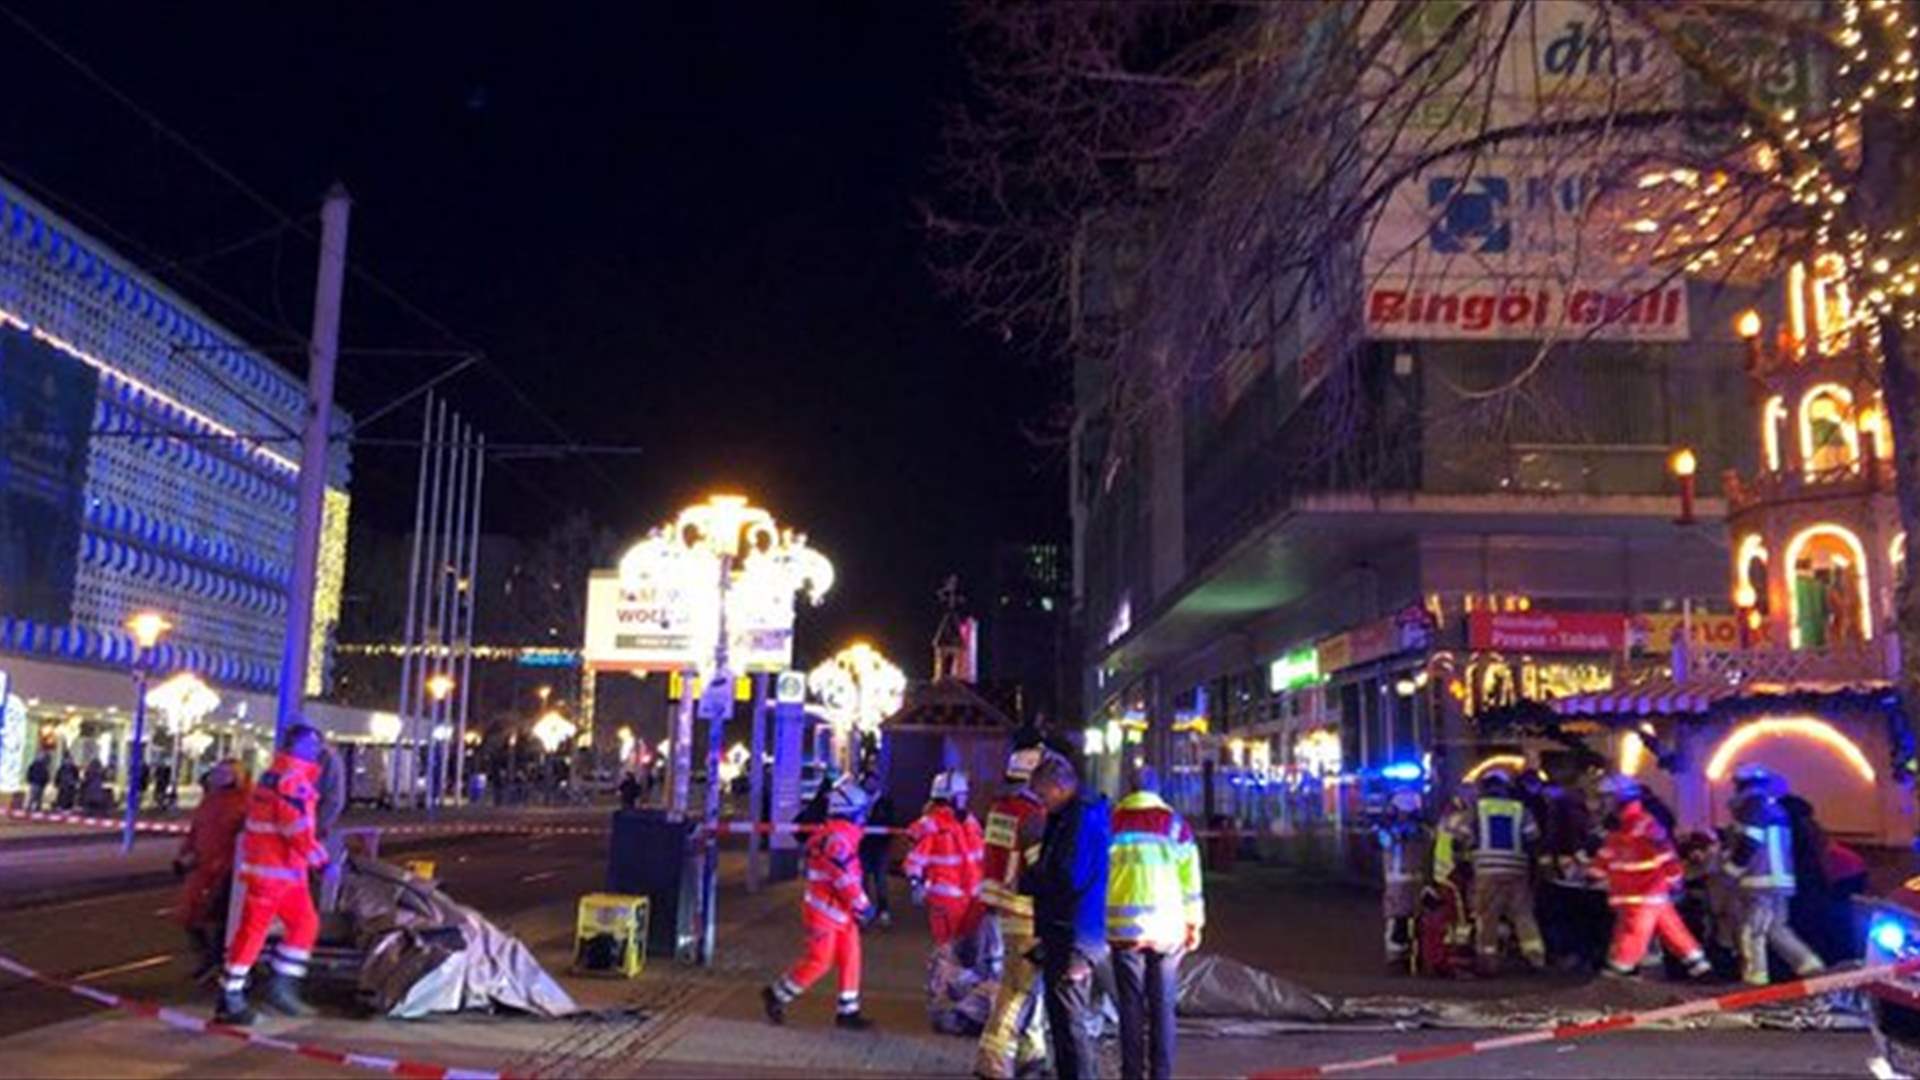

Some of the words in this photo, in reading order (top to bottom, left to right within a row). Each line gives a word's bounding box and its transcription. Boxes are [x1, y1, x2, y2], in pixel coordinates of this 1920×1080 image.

[1545, 22, 1645, 75] dm
[1367, 287, 1549, 331] Bingöl
[1567, 289, 1683, 325] Grill
